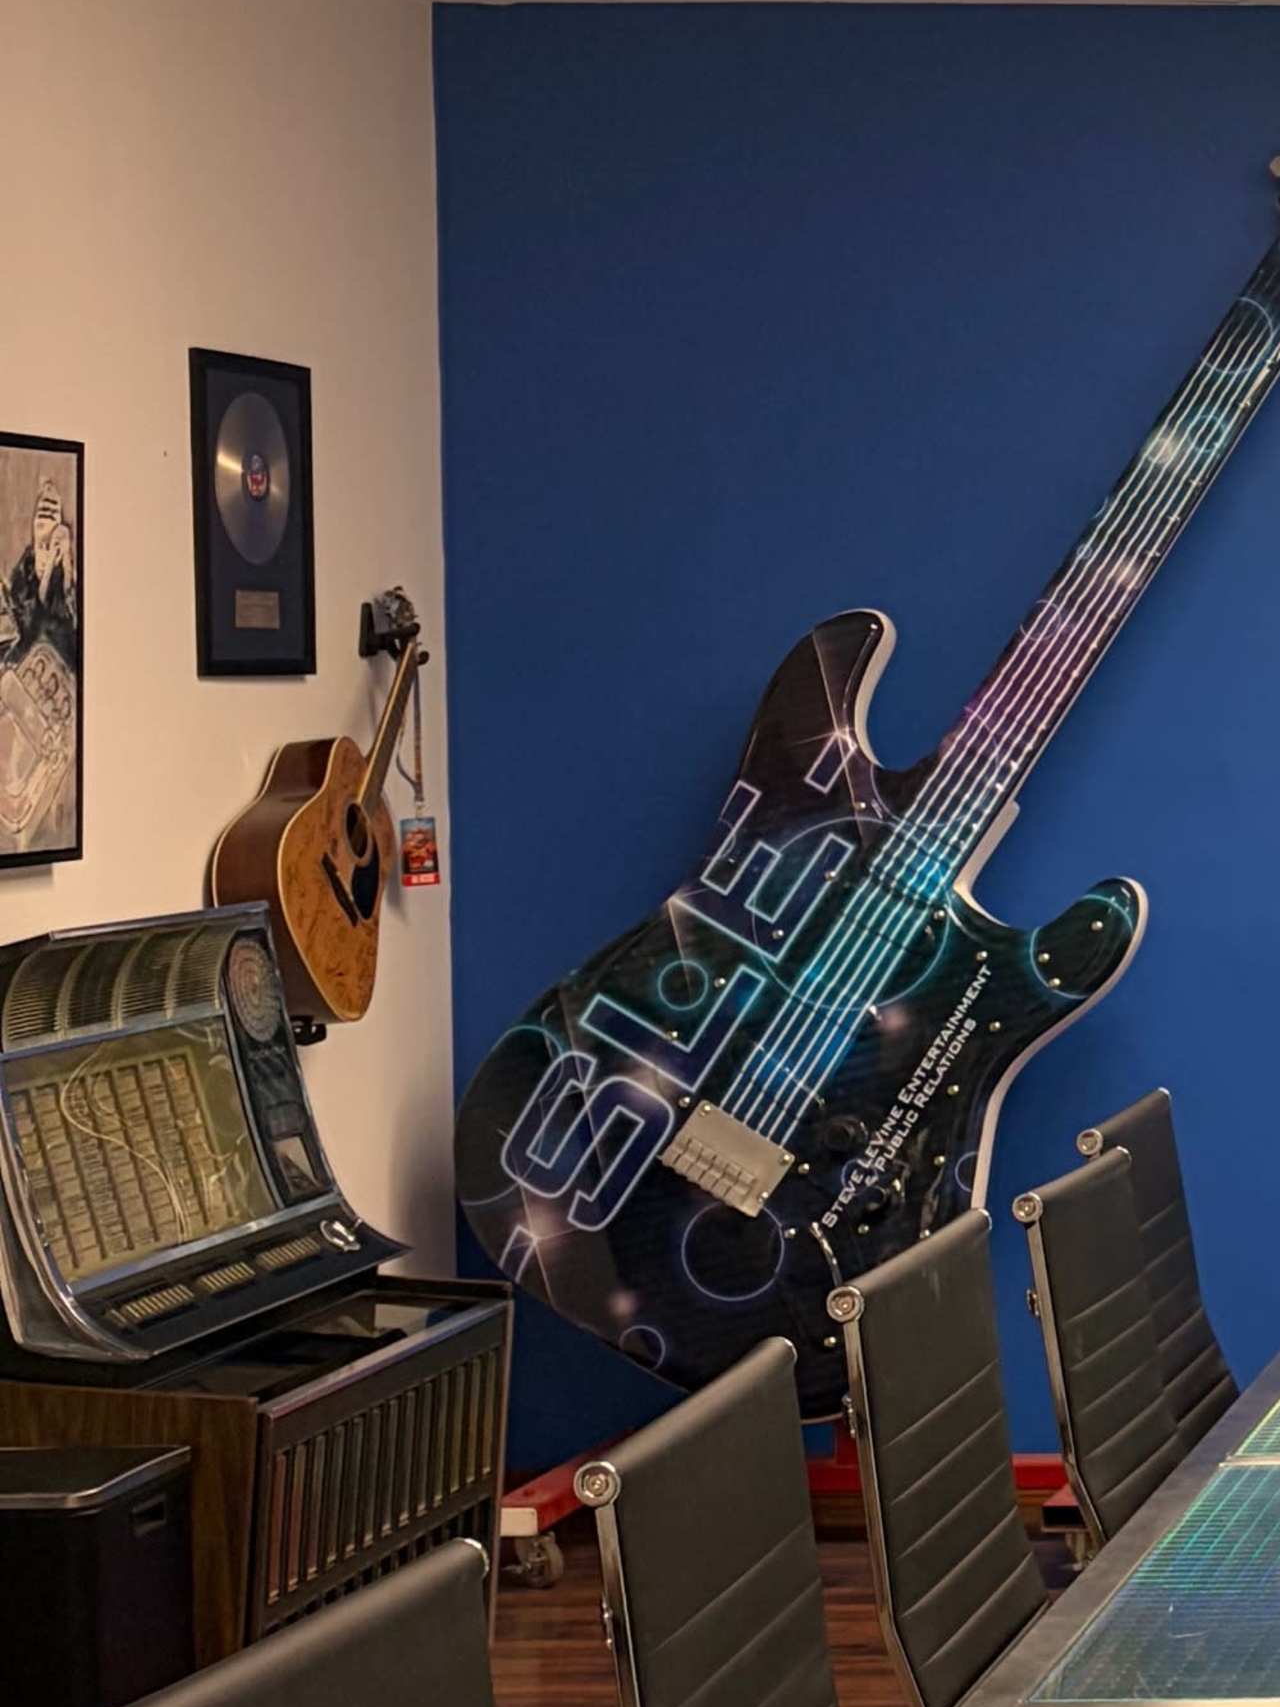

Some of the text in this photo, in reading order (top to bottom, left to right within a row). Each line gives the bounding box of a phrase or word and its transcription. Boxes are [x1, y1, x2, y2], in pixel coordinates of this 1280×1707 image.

[820, 1169, 864, 1229] STEVE
[898, 963, 993, 1106] ENTERTAINMENT
[872, 1109, 919, 1173] PUBLIC
[912, 1017, 977, 1109] RELATIONS
